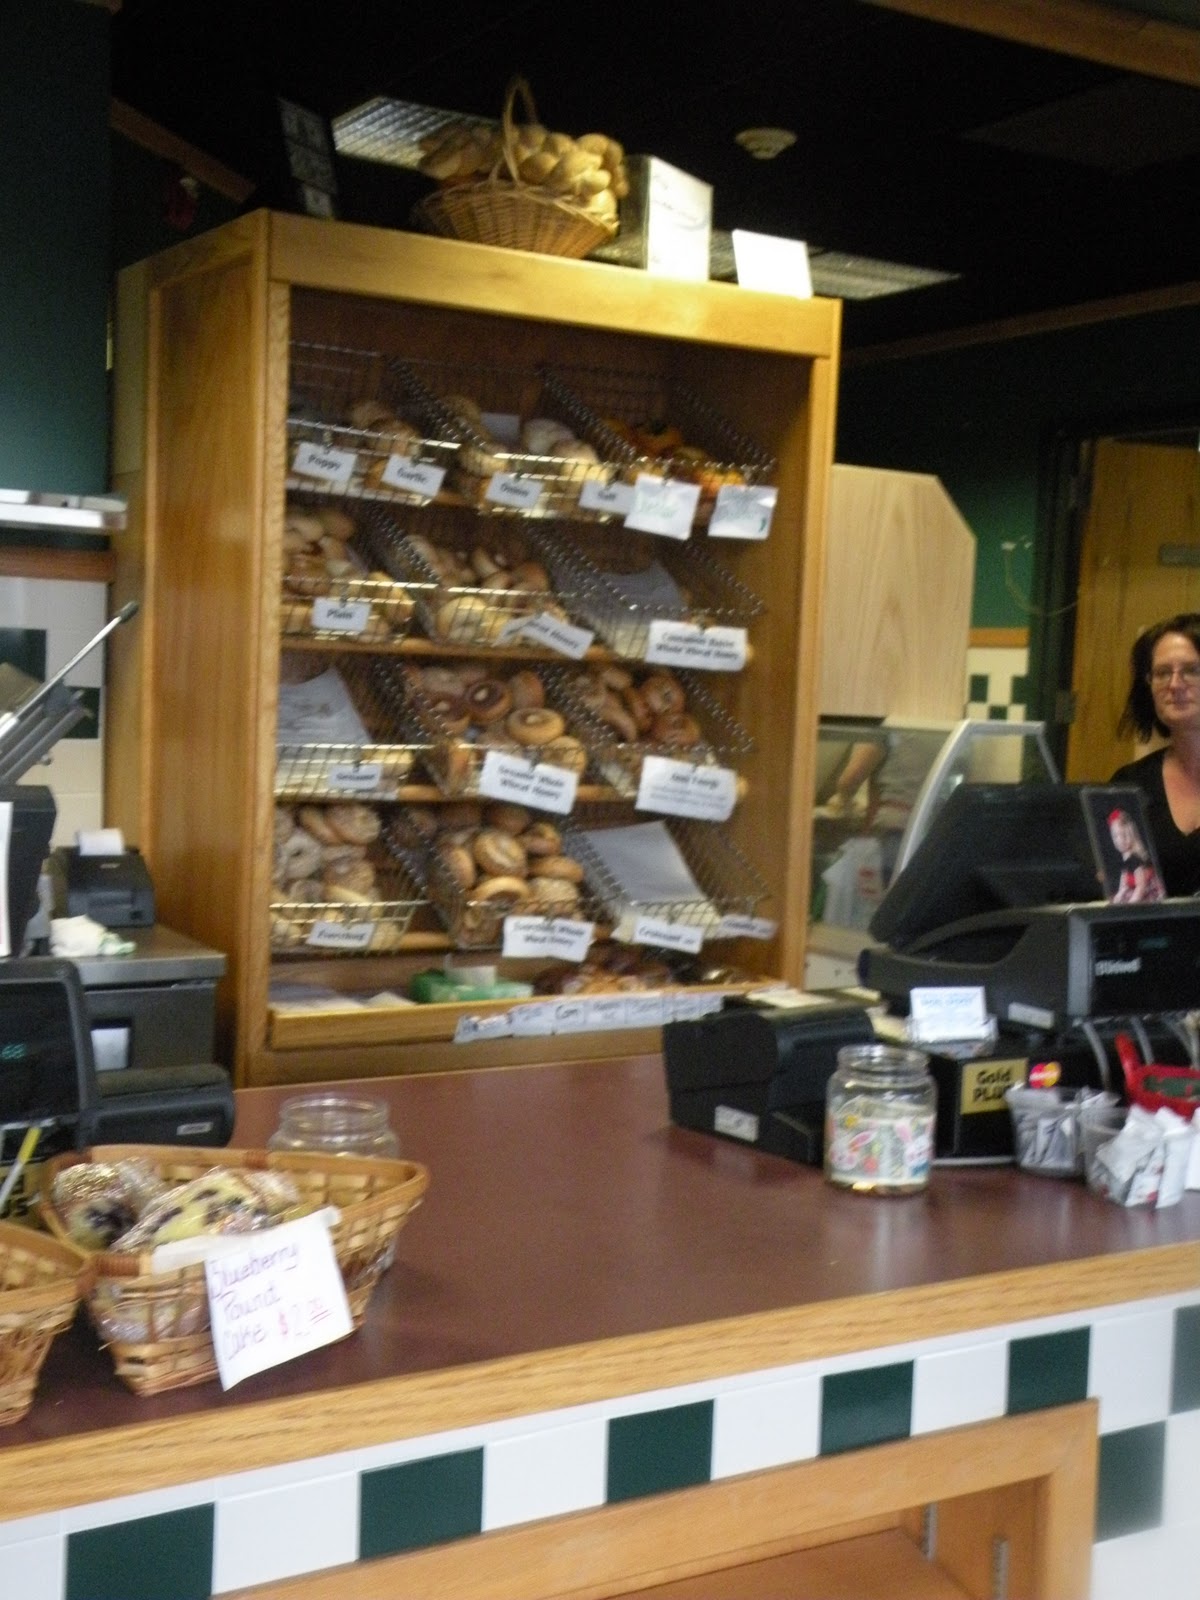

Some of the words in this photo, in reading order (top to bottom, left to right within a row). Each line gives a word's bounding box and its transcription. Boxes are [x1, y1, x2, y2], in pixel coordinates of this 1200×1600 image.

[307, 454, 342, 471] Poppy
[396, 466, 428, 484] Garlic
[326, 608, 354, 620] Plain
[976, 1066, 1013, 1084] Gold
[217, 1281, 282, 1324] Pound
